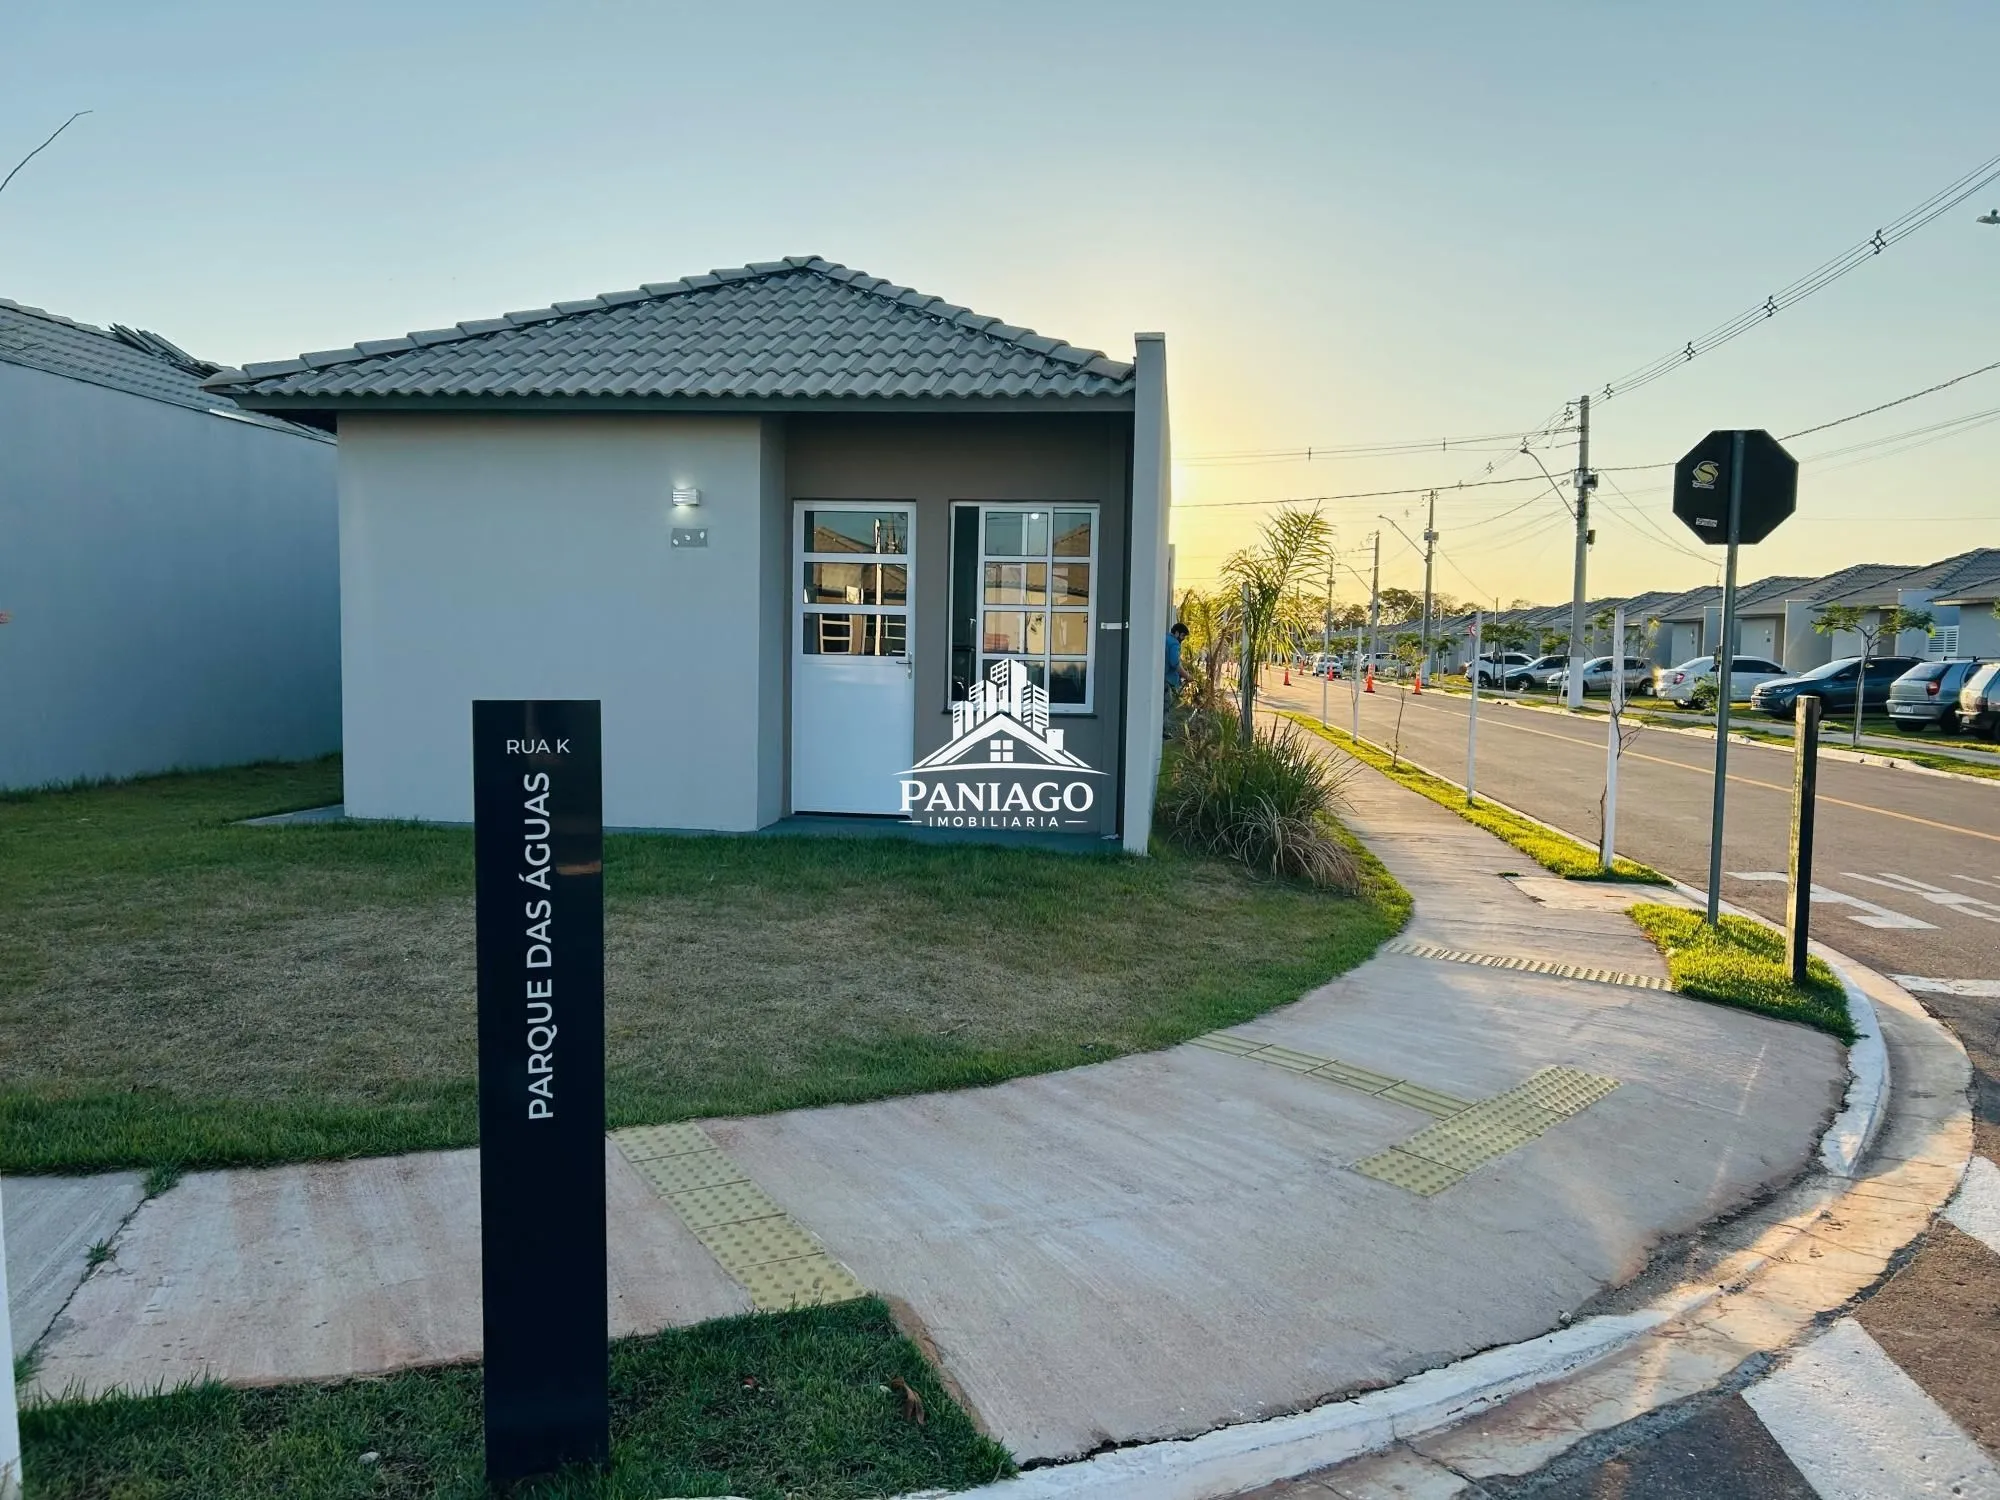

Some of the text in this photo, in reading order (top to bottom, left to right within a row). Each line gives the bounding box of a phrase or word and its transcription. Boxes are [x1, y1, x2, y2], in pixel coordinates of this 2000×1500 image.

[506, 738, 570, 755] RUA K
[518, 772, 558, 1120] PARQUE DAS ÁGUAS
